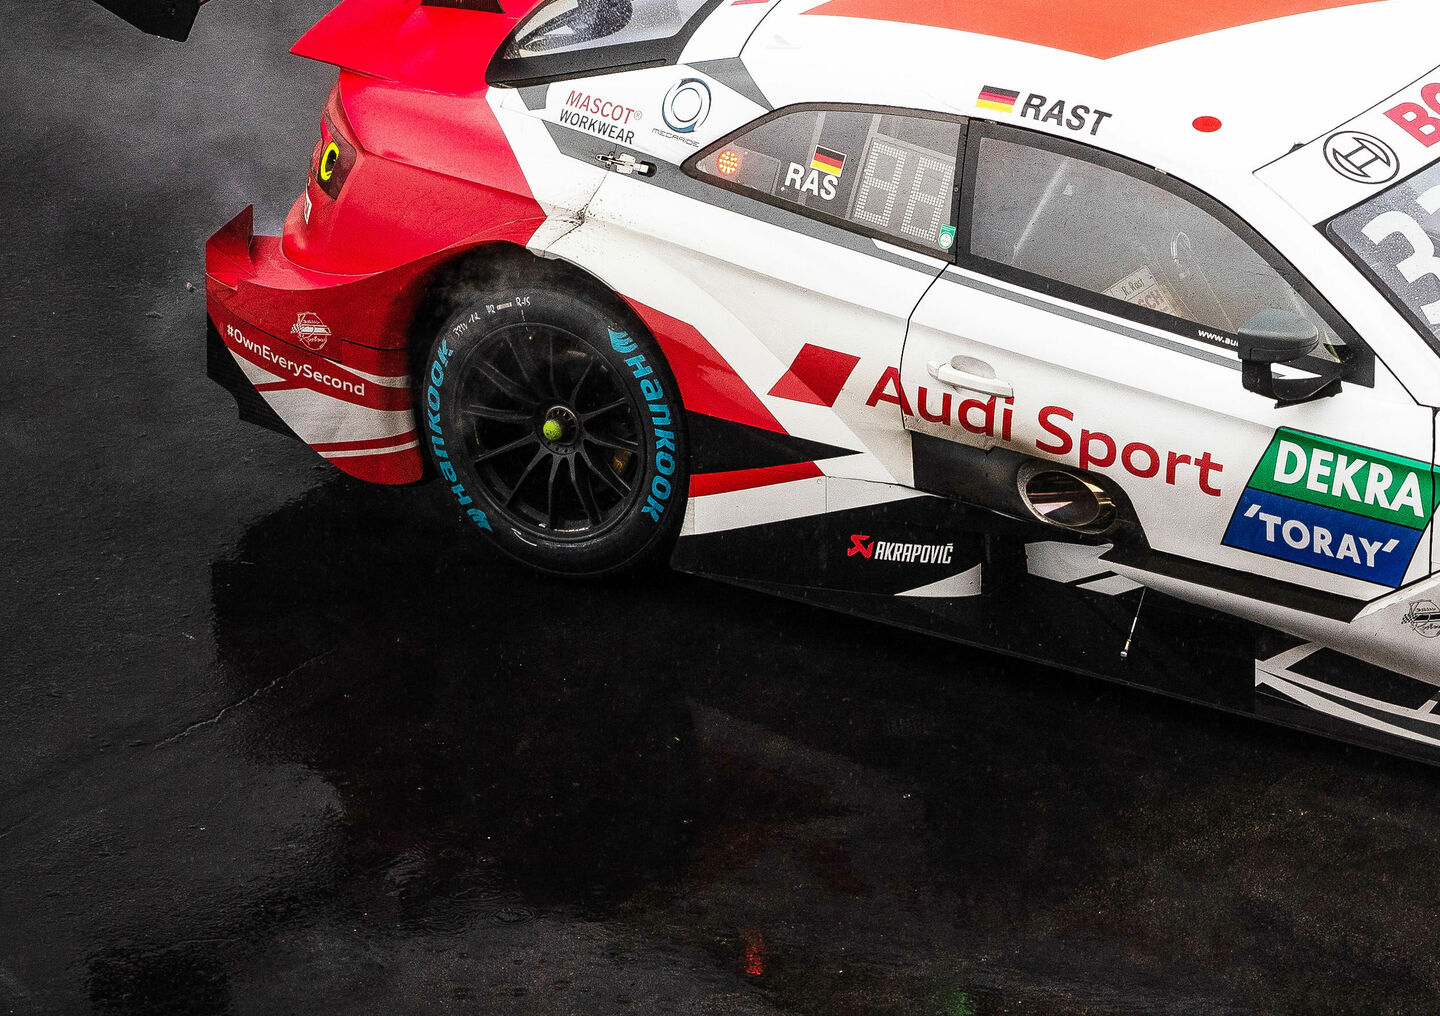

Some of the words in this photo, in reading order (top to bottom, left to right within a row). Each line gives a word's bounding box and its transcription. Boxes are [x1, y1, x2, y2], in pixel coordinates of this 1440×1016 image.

[559, 108, 635, 145] WORKWEAR
[1020, 94, 1112, 135] RAST
[784, 161, 838, 201] RAS
[226, 323, 366, 397] #OwnEverySecond
[865, 366, 1014, 442] Audi
[1035, 405, 1223, 497] Sport
[1273, 439, 1425, 519] DEKRA
